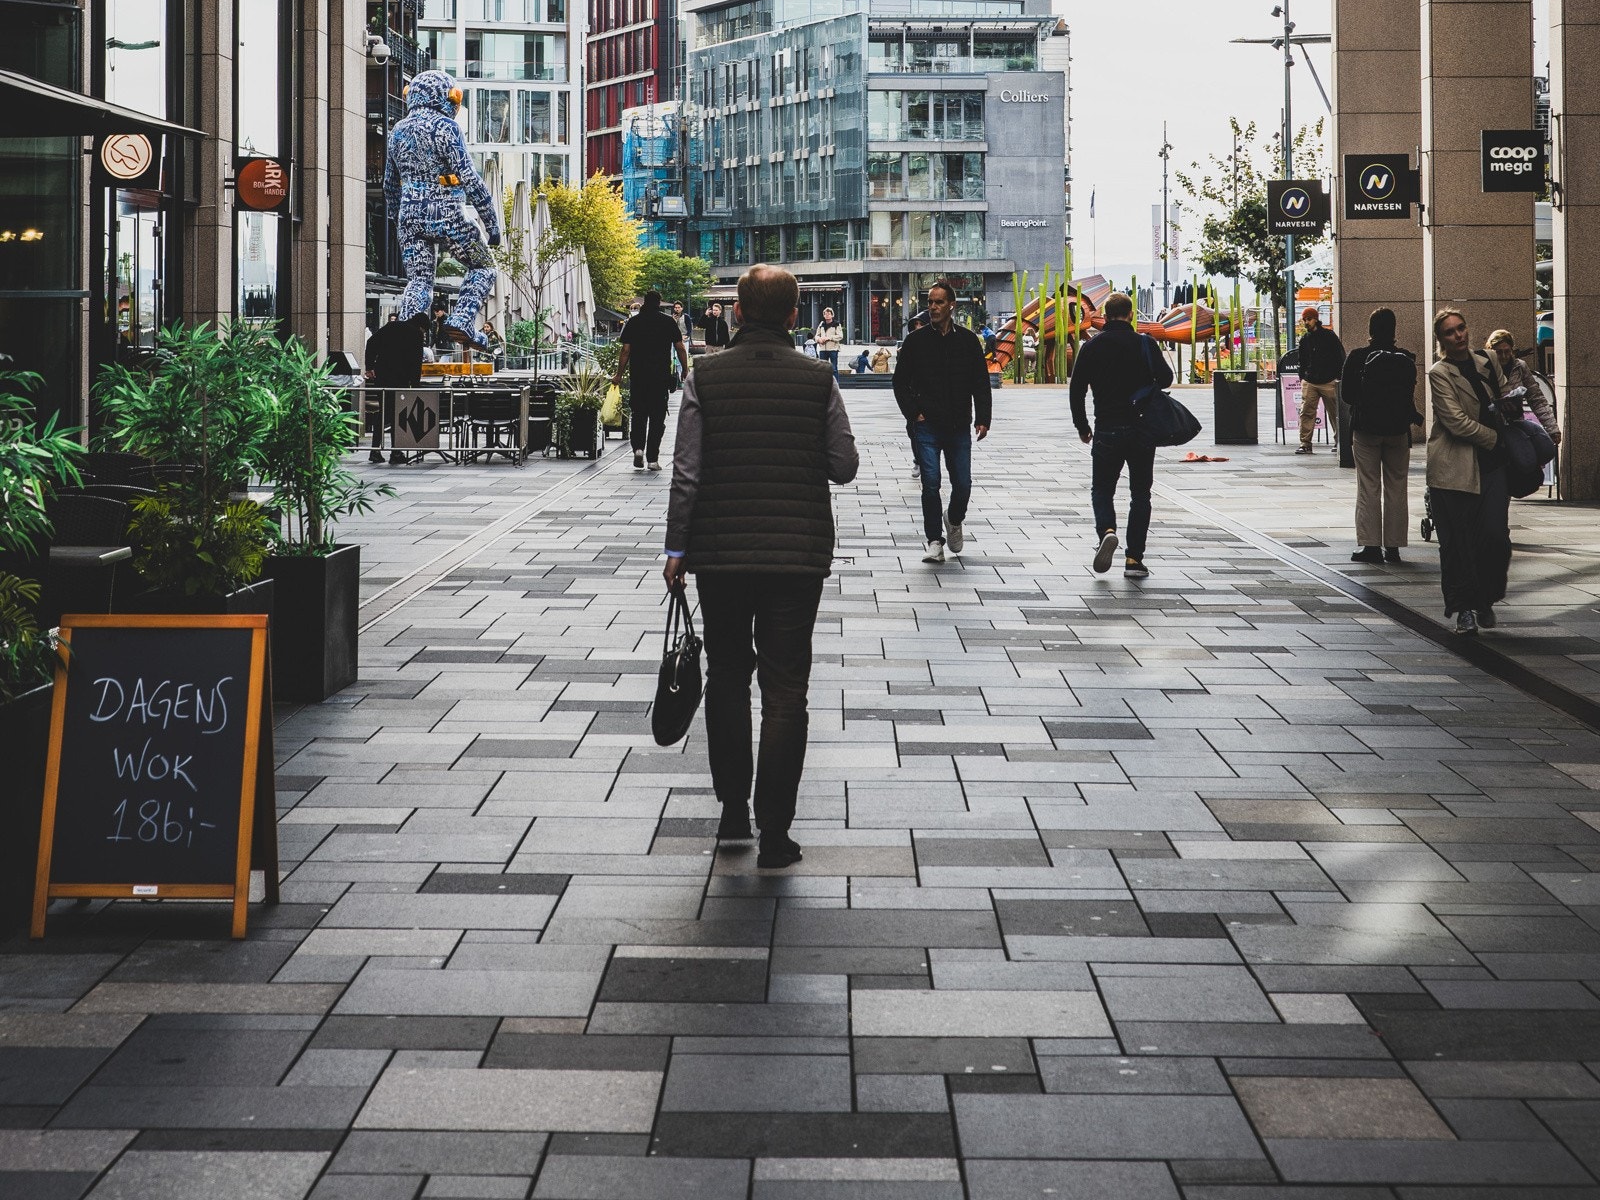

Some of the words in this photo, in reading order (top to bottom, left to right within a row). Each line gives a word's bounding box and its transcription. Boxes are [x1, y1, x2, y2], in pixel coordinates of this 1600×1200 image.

[1000, 89, 1049, 103] Colliers
[1490, 146, 1538, 161] coop
[265, 159, 282, 188] ARK
[1490, 162, 1533, 175] mega
[264, 188, 286, 196] HANDEL
[1354, 203, 1402, 211] NARVESEN
[1275, 220, 1317, 228] NARVESEN
[89, 676, 233, 734] DAGENS
[113, 737, 198, 792] WOK
